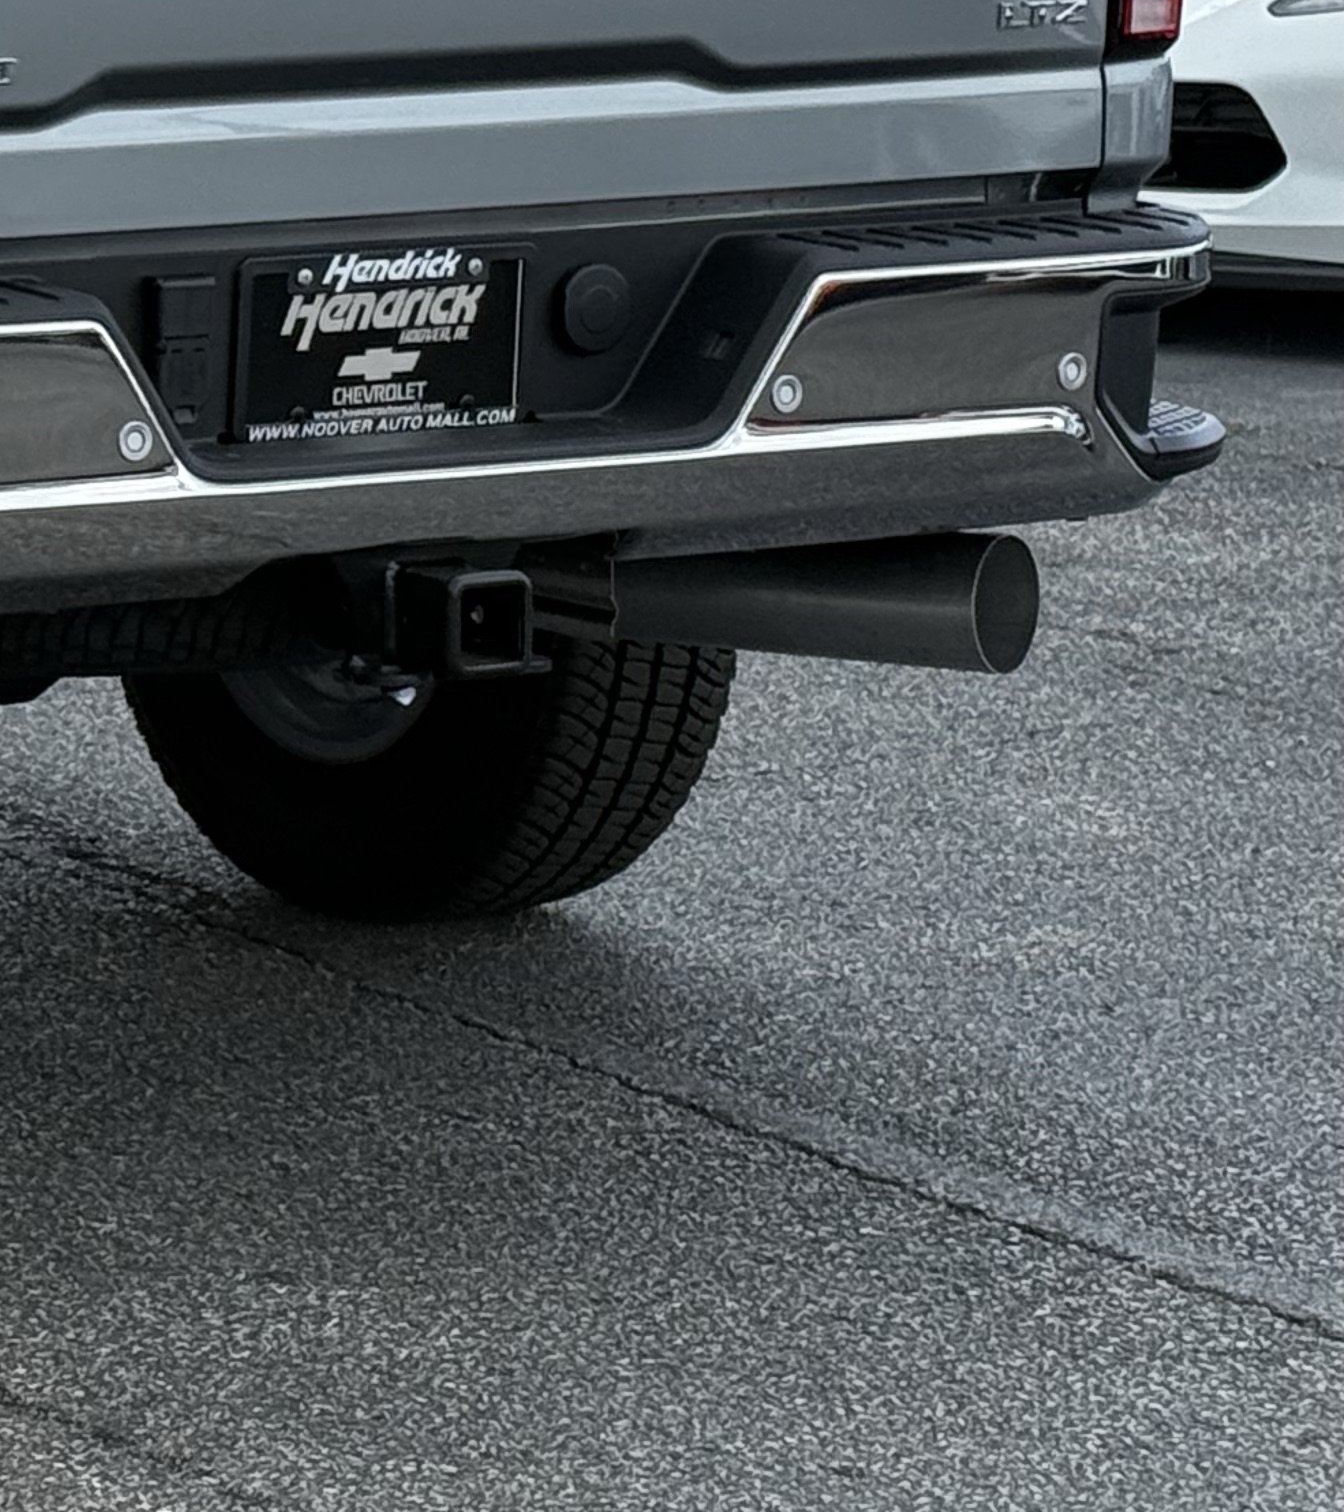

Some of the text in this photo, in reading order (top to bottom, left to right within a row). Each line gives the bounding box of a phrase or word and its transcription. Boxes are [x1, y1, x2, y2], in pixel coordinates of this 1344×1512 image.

[321, 247, 462, 293] Hendrick
[279, 284, 486, 352] Hendrick
[332, 380, 427, 407] CHEVROLET
[375, 414, 424, 433] AUTO
